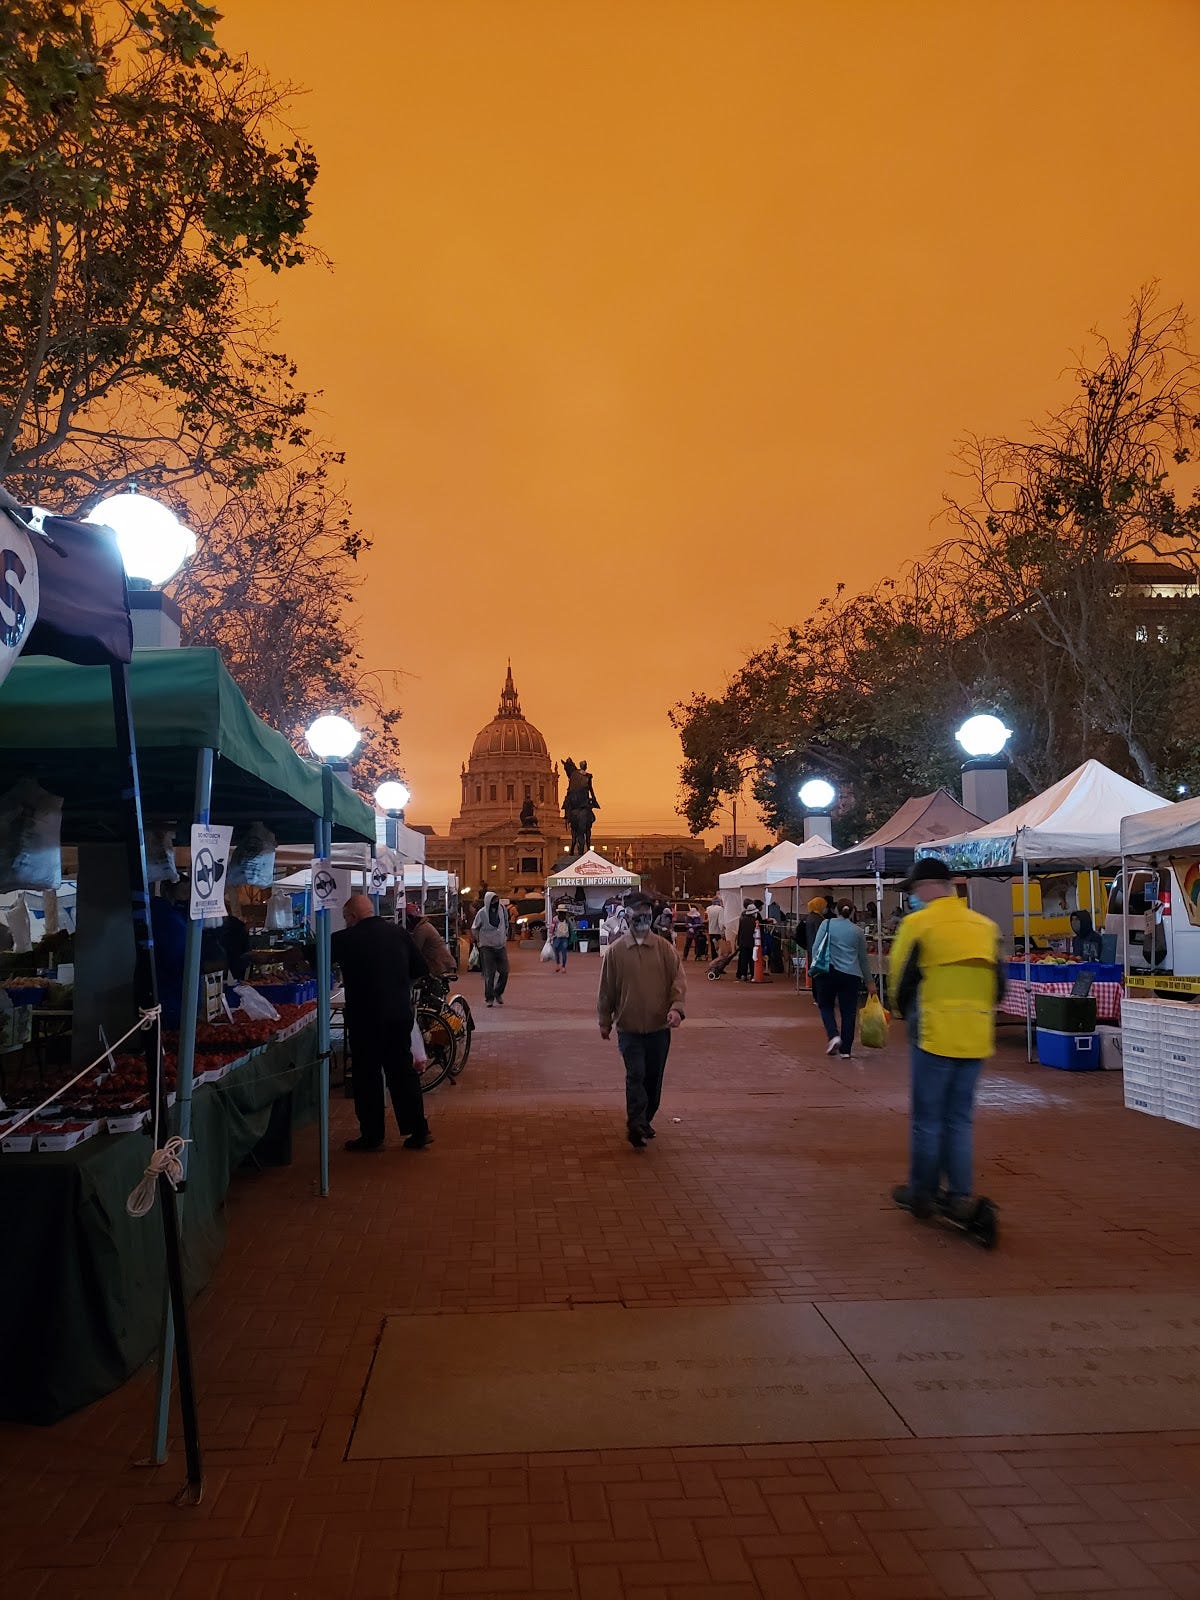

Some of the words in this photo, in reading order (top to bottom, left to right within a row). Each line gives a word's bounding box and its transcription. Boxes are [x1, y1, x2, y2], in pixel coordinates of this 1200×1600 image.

[556, 878, 584, 886] MARKET
[586, 877, 632, 885] INFORMATION
[895, 1350, 965, 1362] AND
